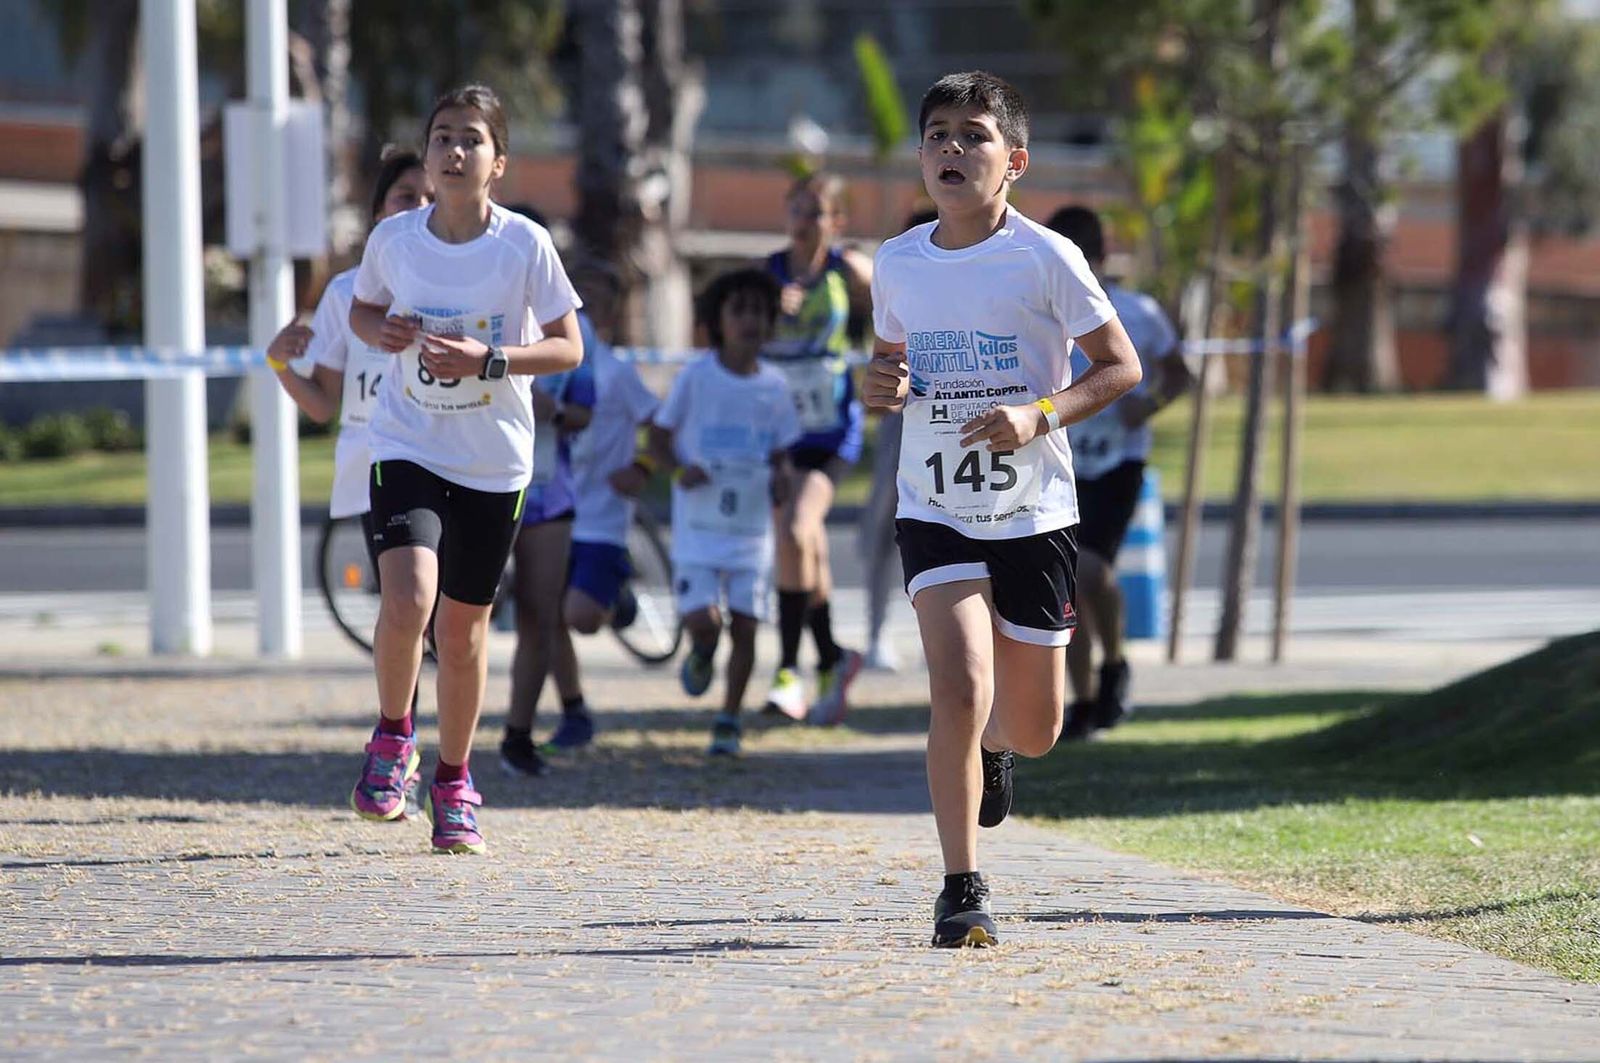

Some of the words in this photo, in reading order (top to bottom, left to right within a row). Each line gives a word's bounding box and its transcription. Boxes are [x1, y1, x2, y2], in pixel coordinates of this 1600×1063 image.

[978, 340, 1018, 355] kilos
[981, 359, 992, 370] x
[994, 355, 1019, 371] km
[934, 378, 984, 390] Fundación
[934, 390, 985, 400] ATLANTIC
[925, 450, 1018, 494] 145
[976, 513, 992, 523] tus
